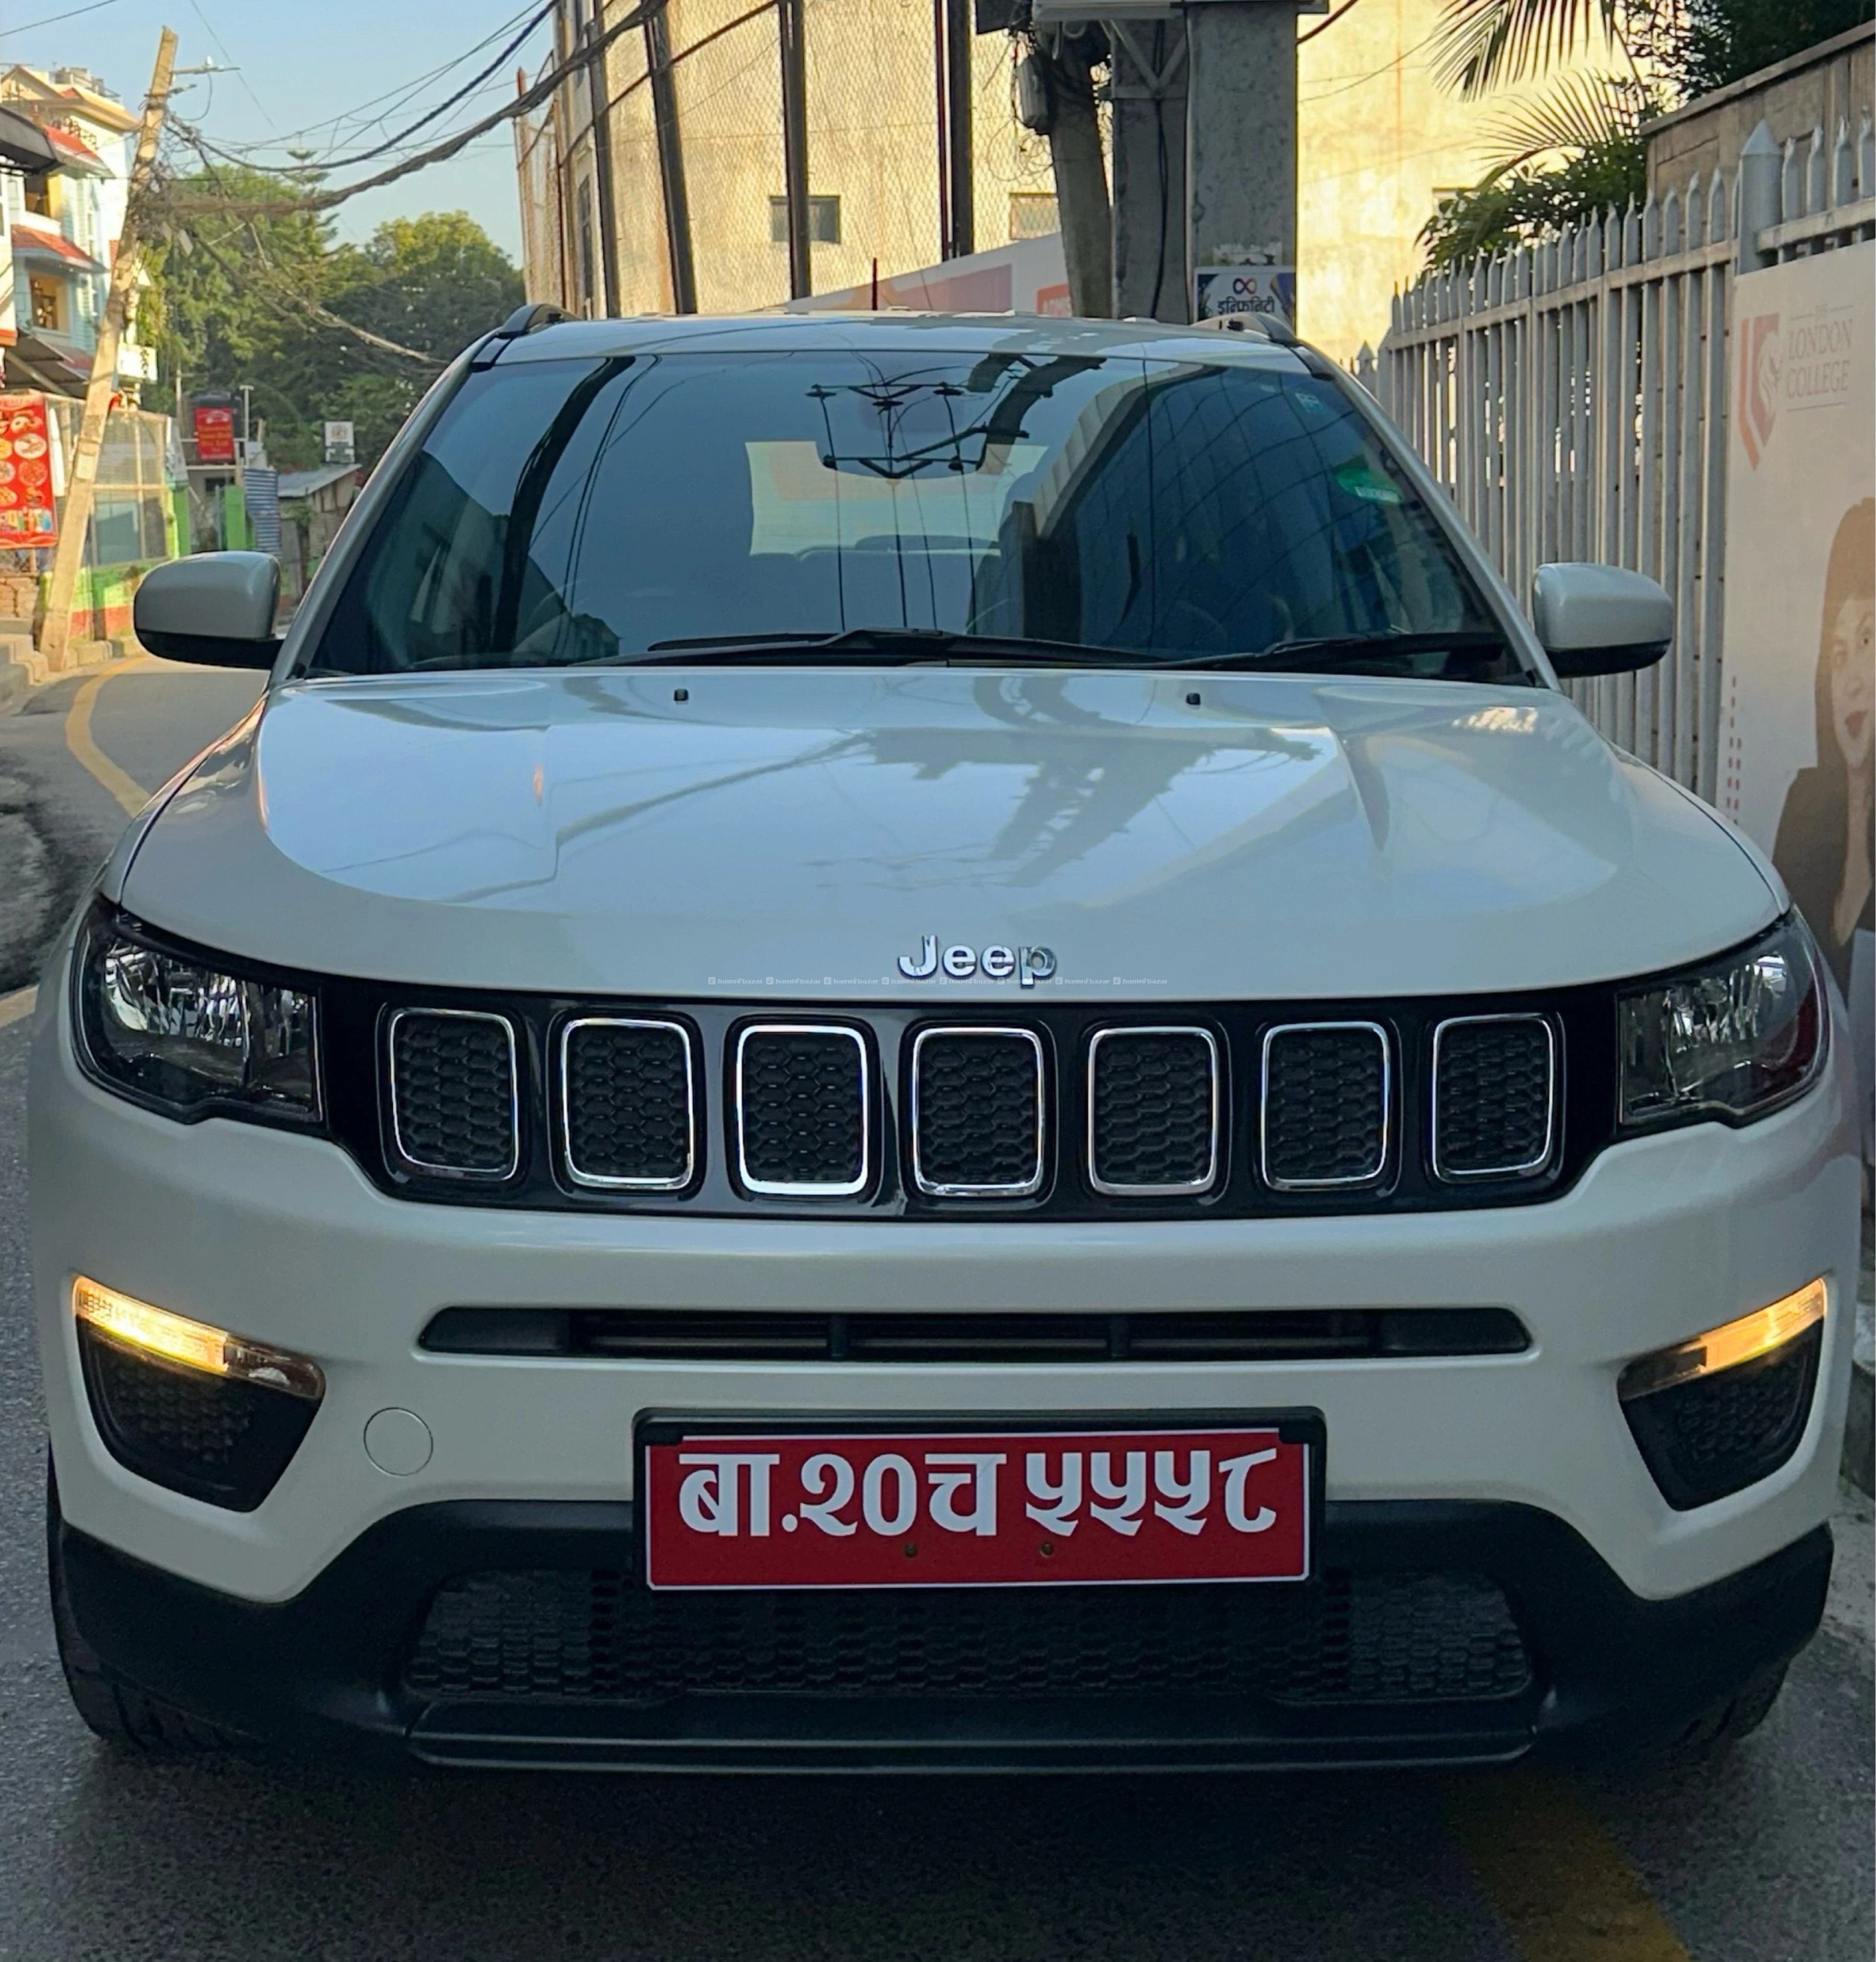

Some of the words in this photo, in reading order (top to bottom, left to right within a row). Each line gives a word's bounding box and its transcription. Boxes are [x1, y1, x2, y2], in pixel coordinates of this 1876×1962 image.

[1789, 318, 1854, 360] LONDON
[1787, 360, 1849, 399] COLLEGE
[898, 935, 1056, 989] Jeep
[1026, 1448, 1277, 1536] ५५५८
